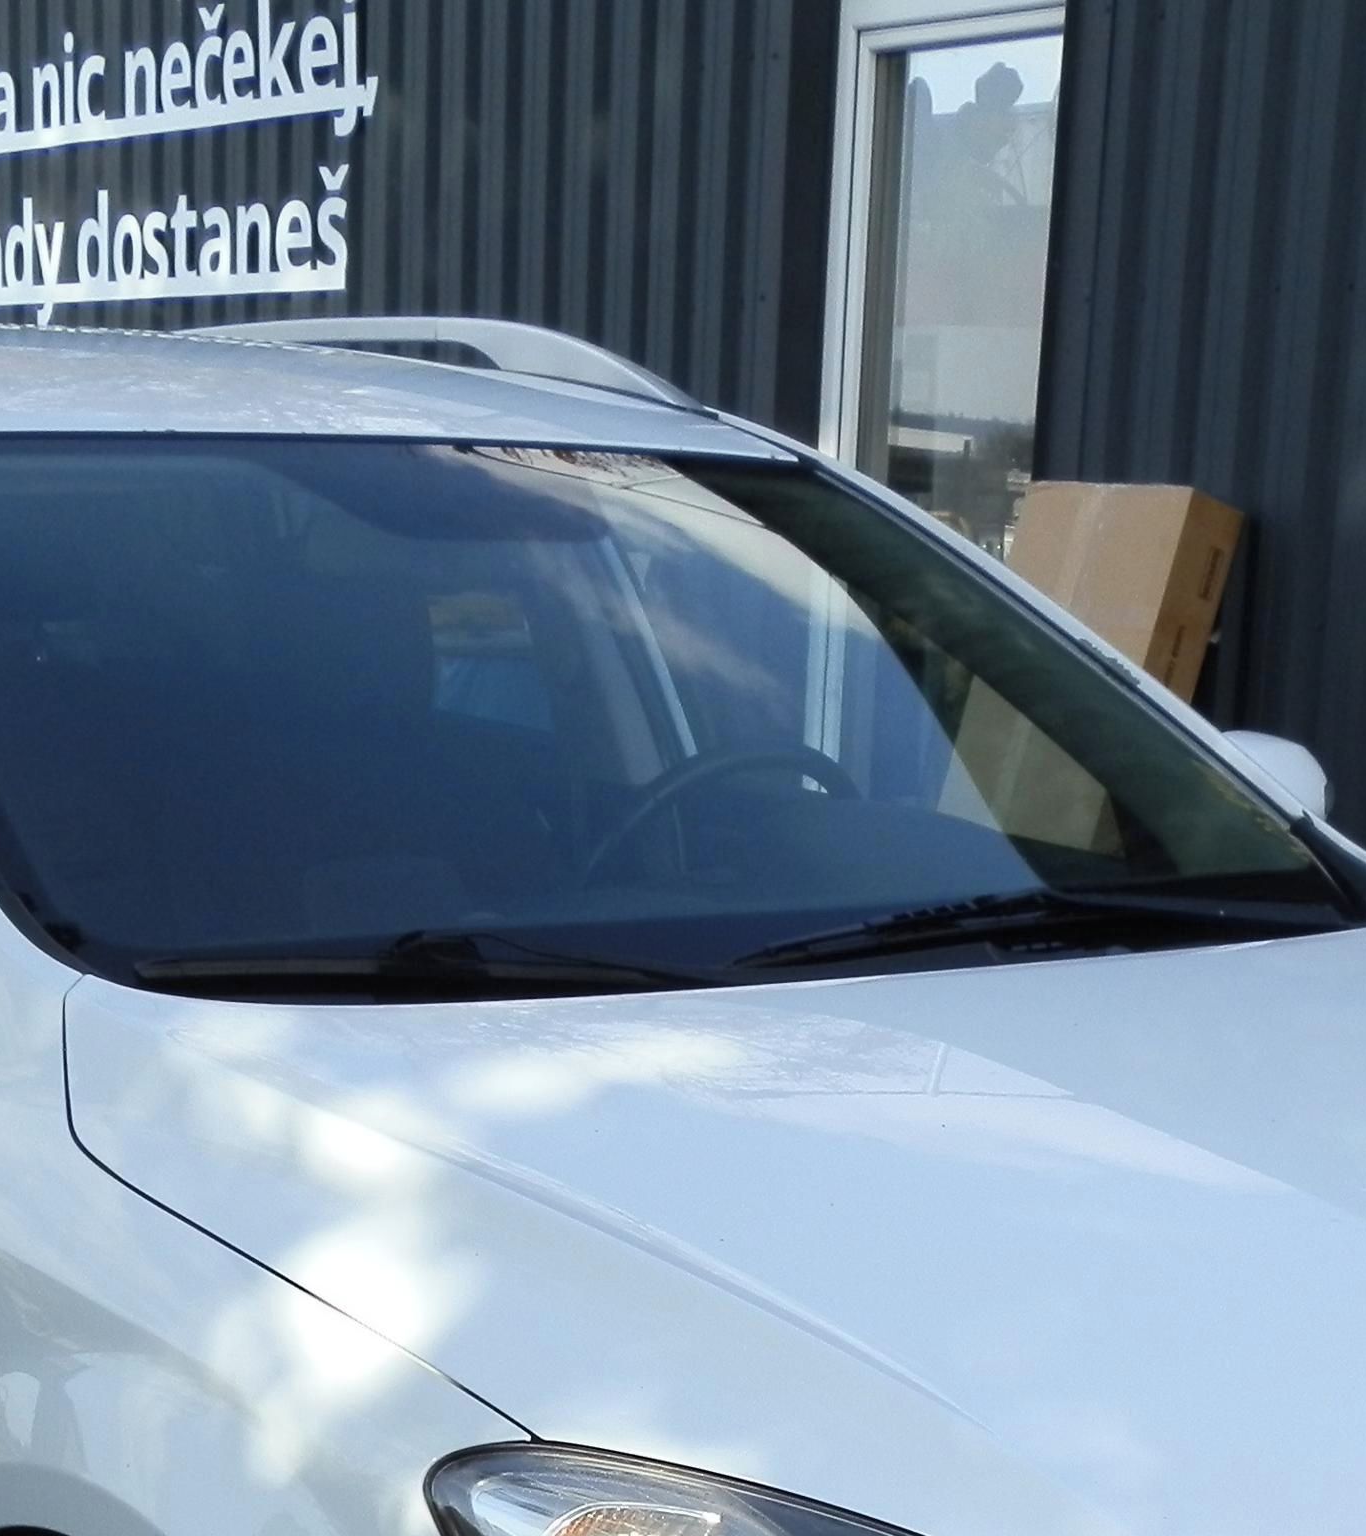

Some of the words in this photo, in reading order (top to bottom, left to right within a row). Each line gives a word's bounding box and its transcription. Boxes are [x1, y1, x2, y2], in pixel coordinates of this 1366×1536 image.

[32, 32, 106, 130] nic
[124, 0, 379, 136] nečekej,
[77, 163, 348, 286] dostaneš
